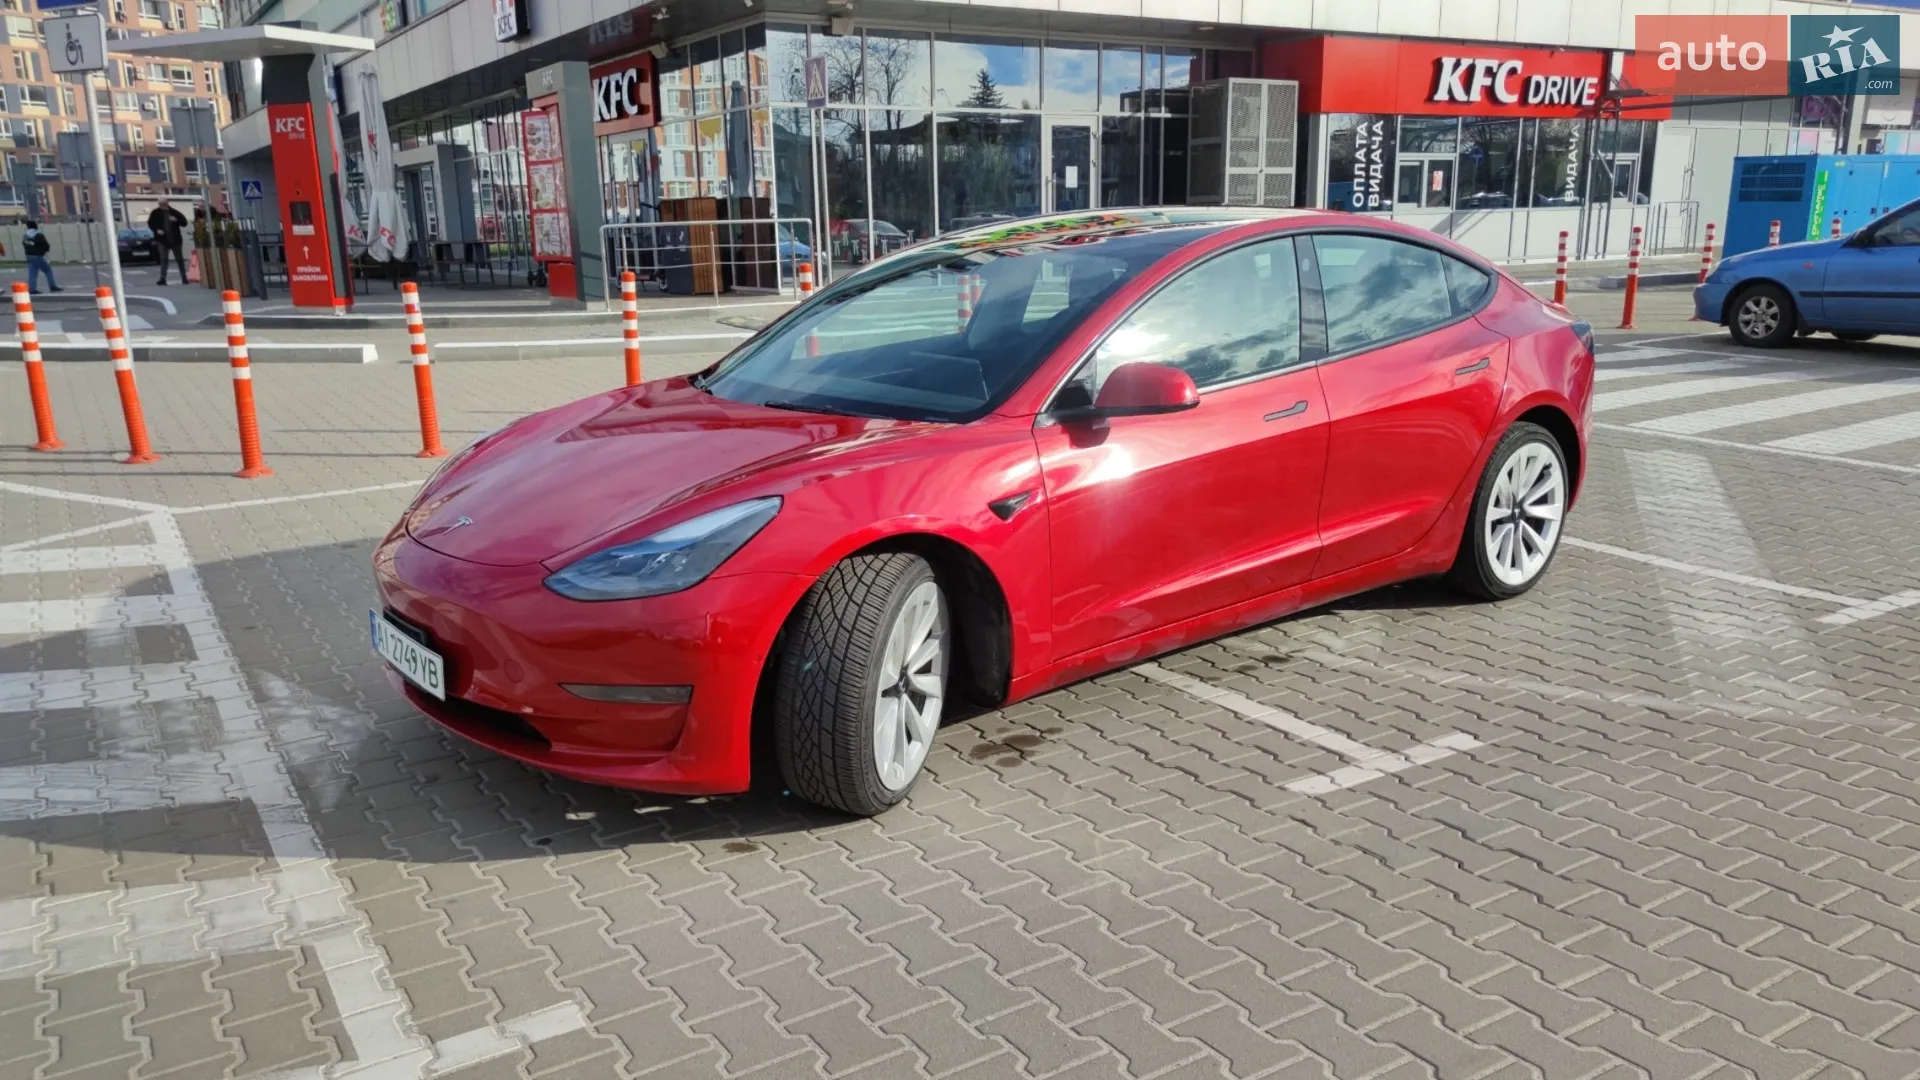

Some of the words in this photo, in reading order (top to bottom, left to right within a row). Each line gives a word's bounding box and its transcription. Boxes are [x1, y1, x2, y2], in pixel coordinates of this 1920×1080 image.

[498, 13, 513, 36] KFC
[592, 68, 638, 123] KFC
[1433, 56, 1523, 104] KFC
[1528, 75, 1598, 106] DRIVE
[275, 116, 305, 133] KFC
[1352, 121, 1368, 208] ОПЛАТА
[1368, 120, 1384, 207] ВИДАЧА
[1564, 124, 1580, 202] ВИДАЧА
